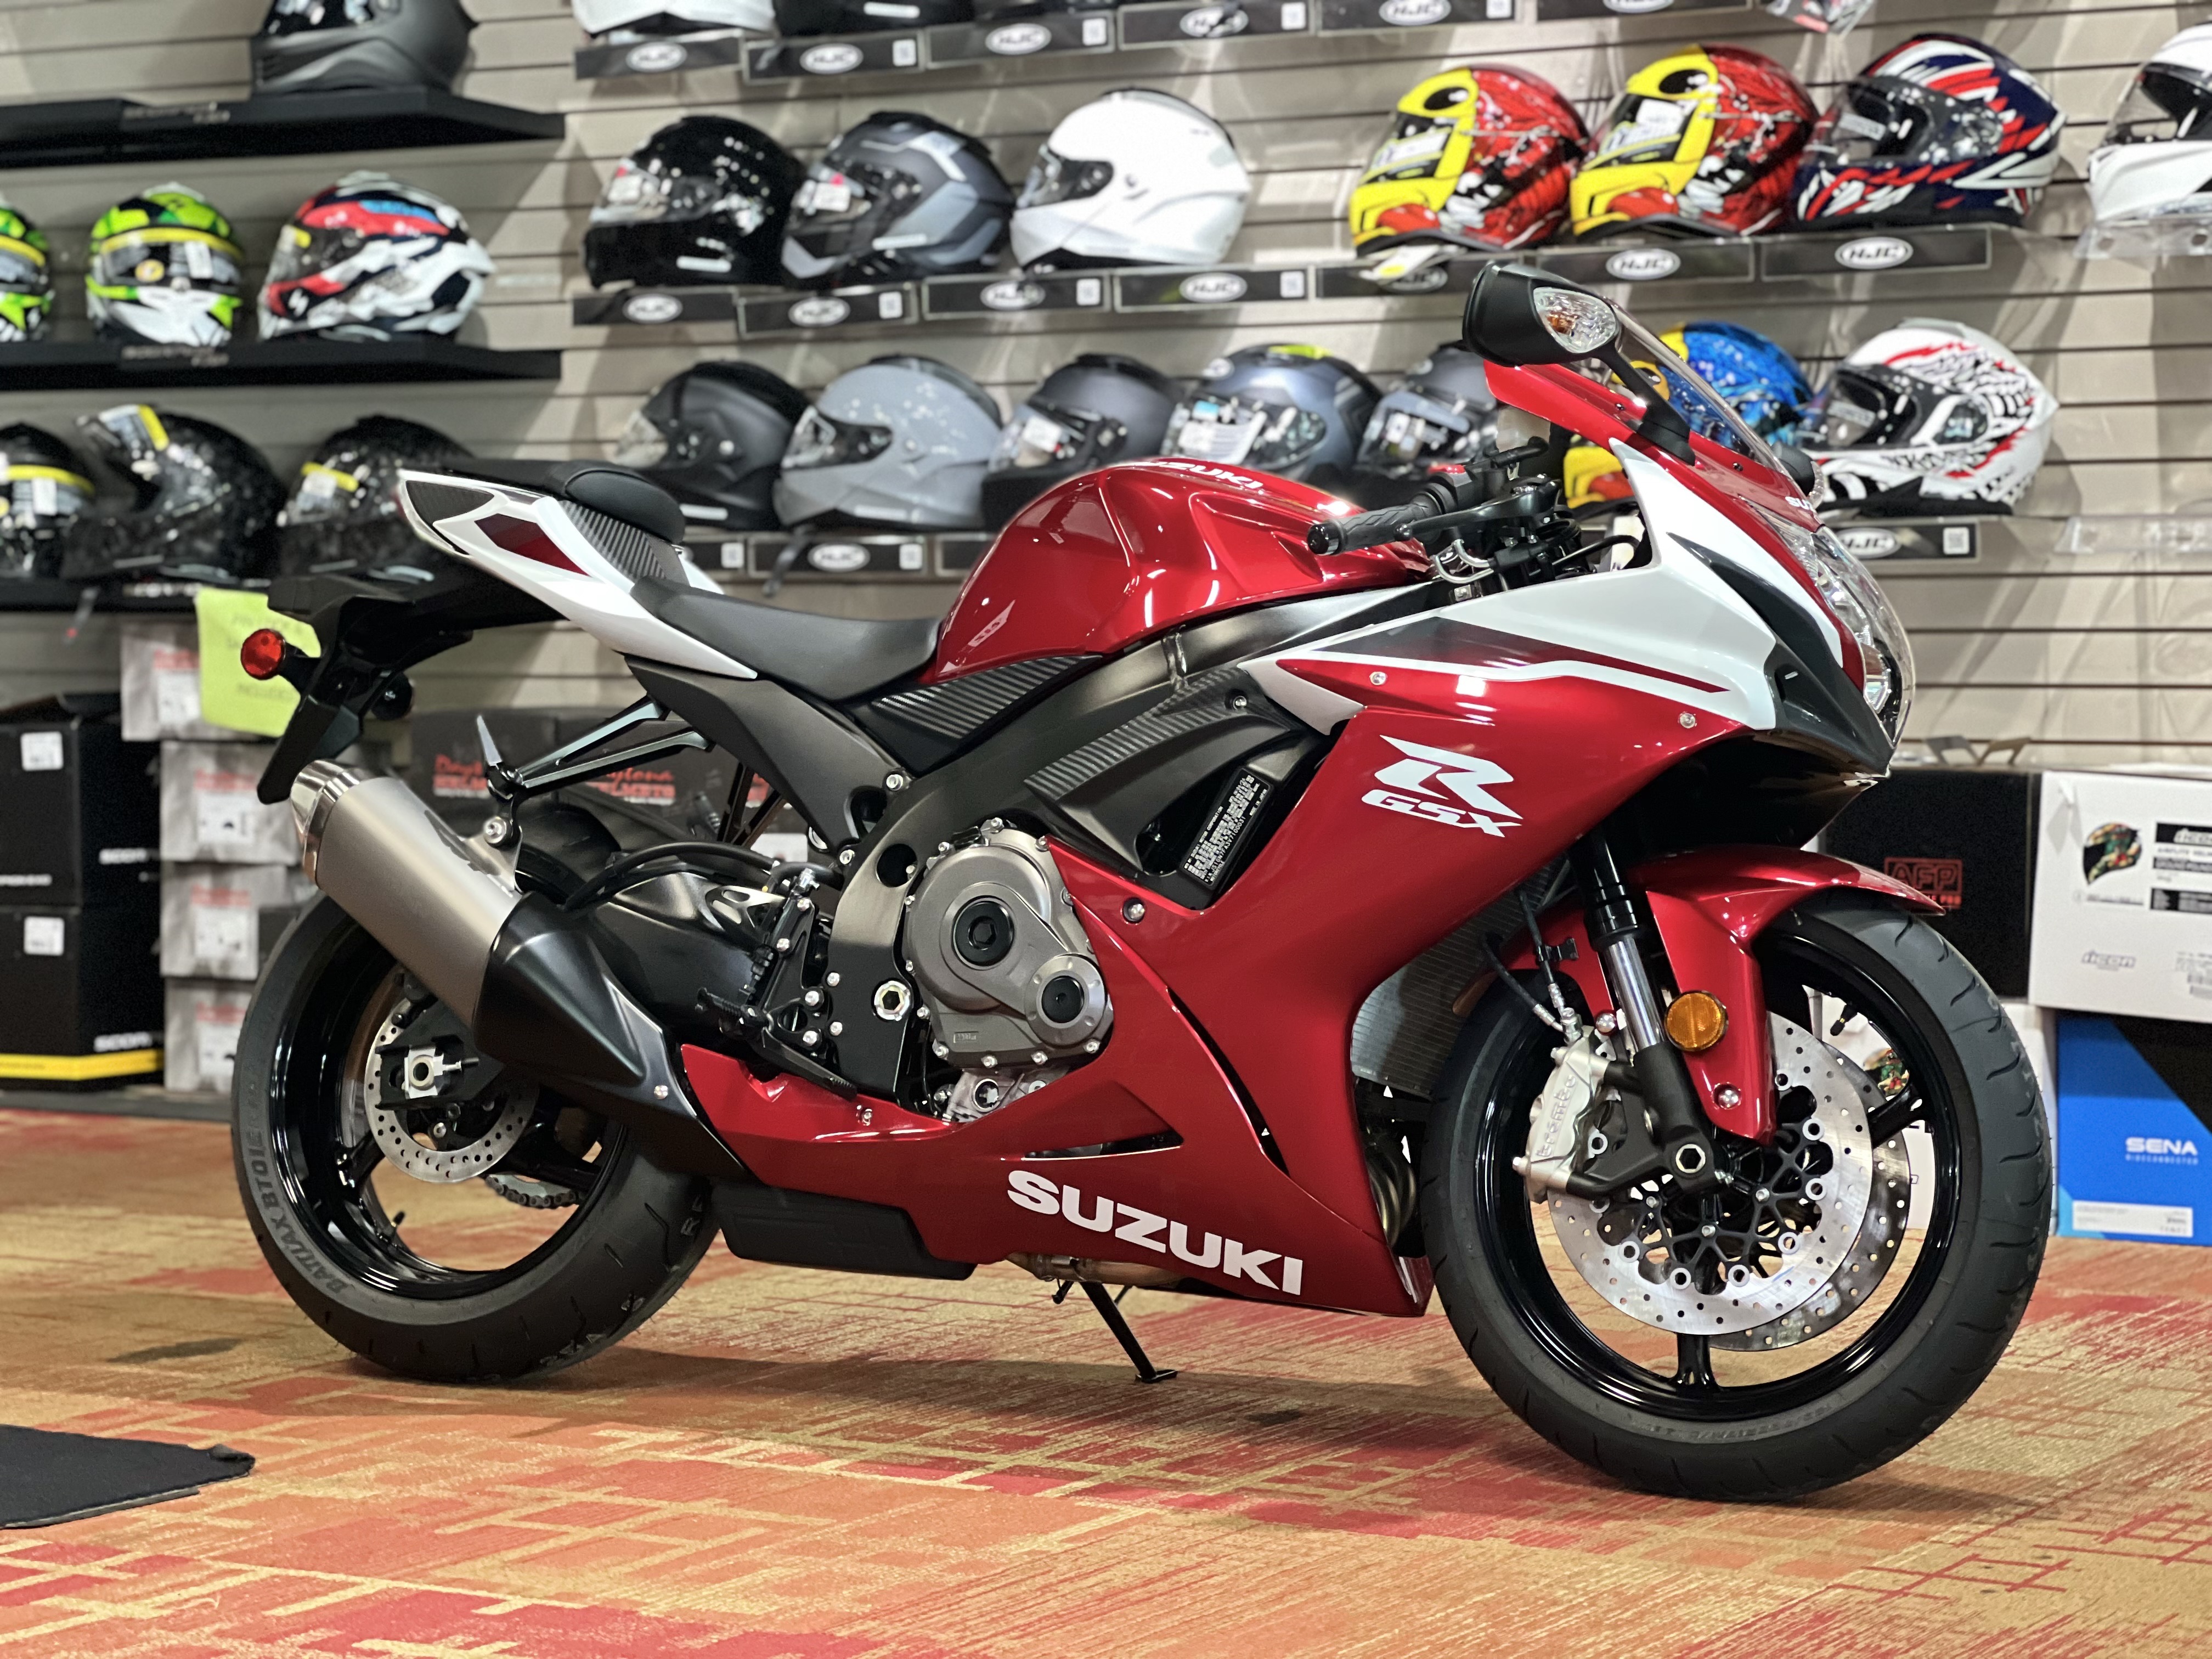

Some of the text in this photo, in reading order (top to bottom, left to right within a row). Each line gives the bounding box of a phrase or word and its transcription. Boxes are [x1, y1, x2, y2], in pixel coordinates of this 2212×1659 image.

[1361, 789, 1522, 838] GSX
[1536, 1074, 1576, 1157] brembo
[2125, 1136, 2198, 1156] SENA
[1007, 1170, 1303, 1295] SUZUKI
